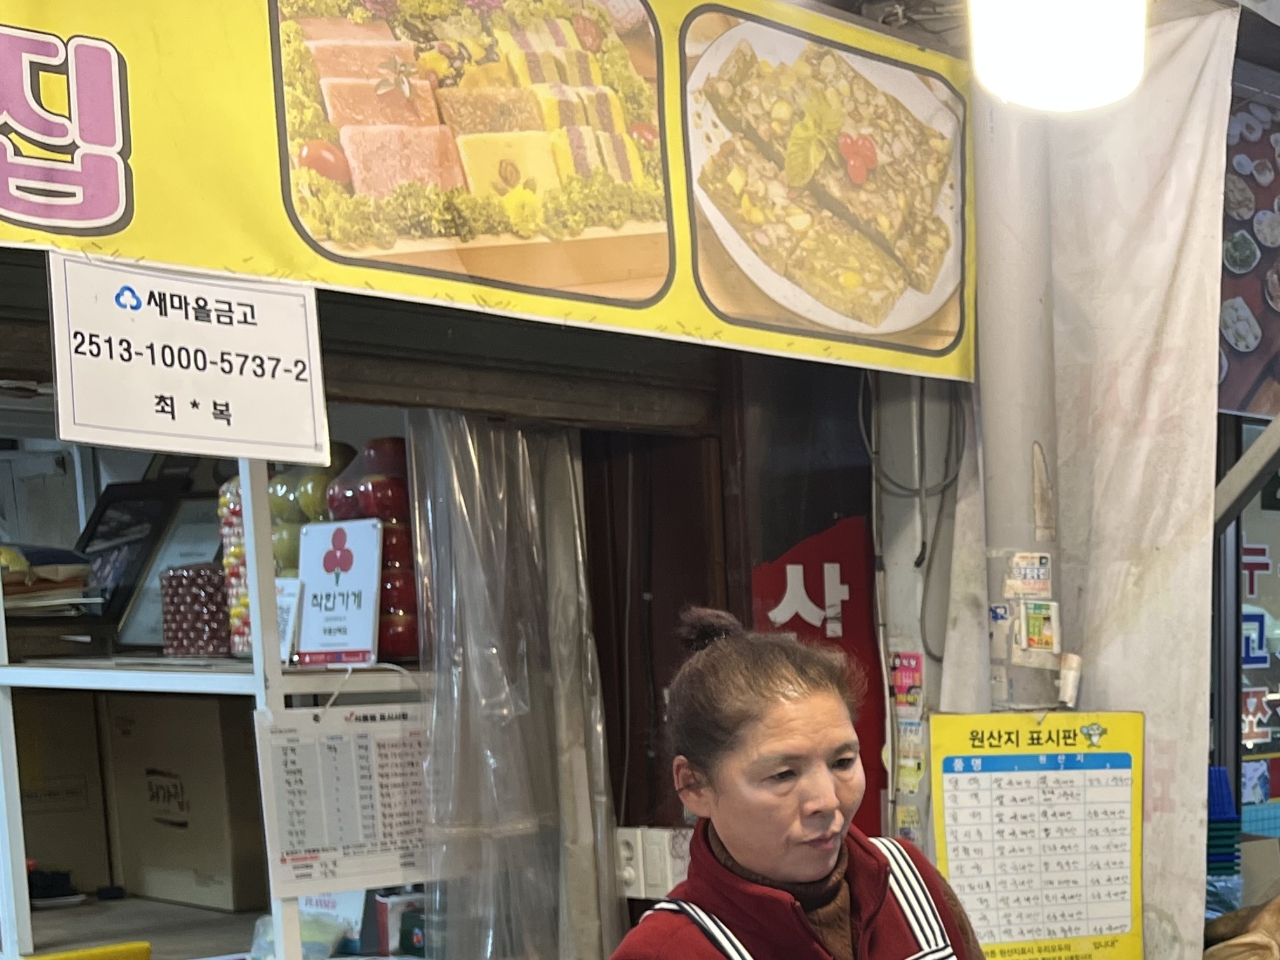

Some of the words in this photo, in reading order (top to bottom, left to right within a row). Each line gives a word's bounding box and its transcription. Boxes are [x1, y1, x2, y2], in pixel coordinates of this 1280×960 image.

[146, 288, 259, 327] 새마을금고
[72, 330, 309, 383] 2513-1000-5737-2
[968, 729, 1020, 749] 원산지
[1026, 728, 1079, 748] 표시판
